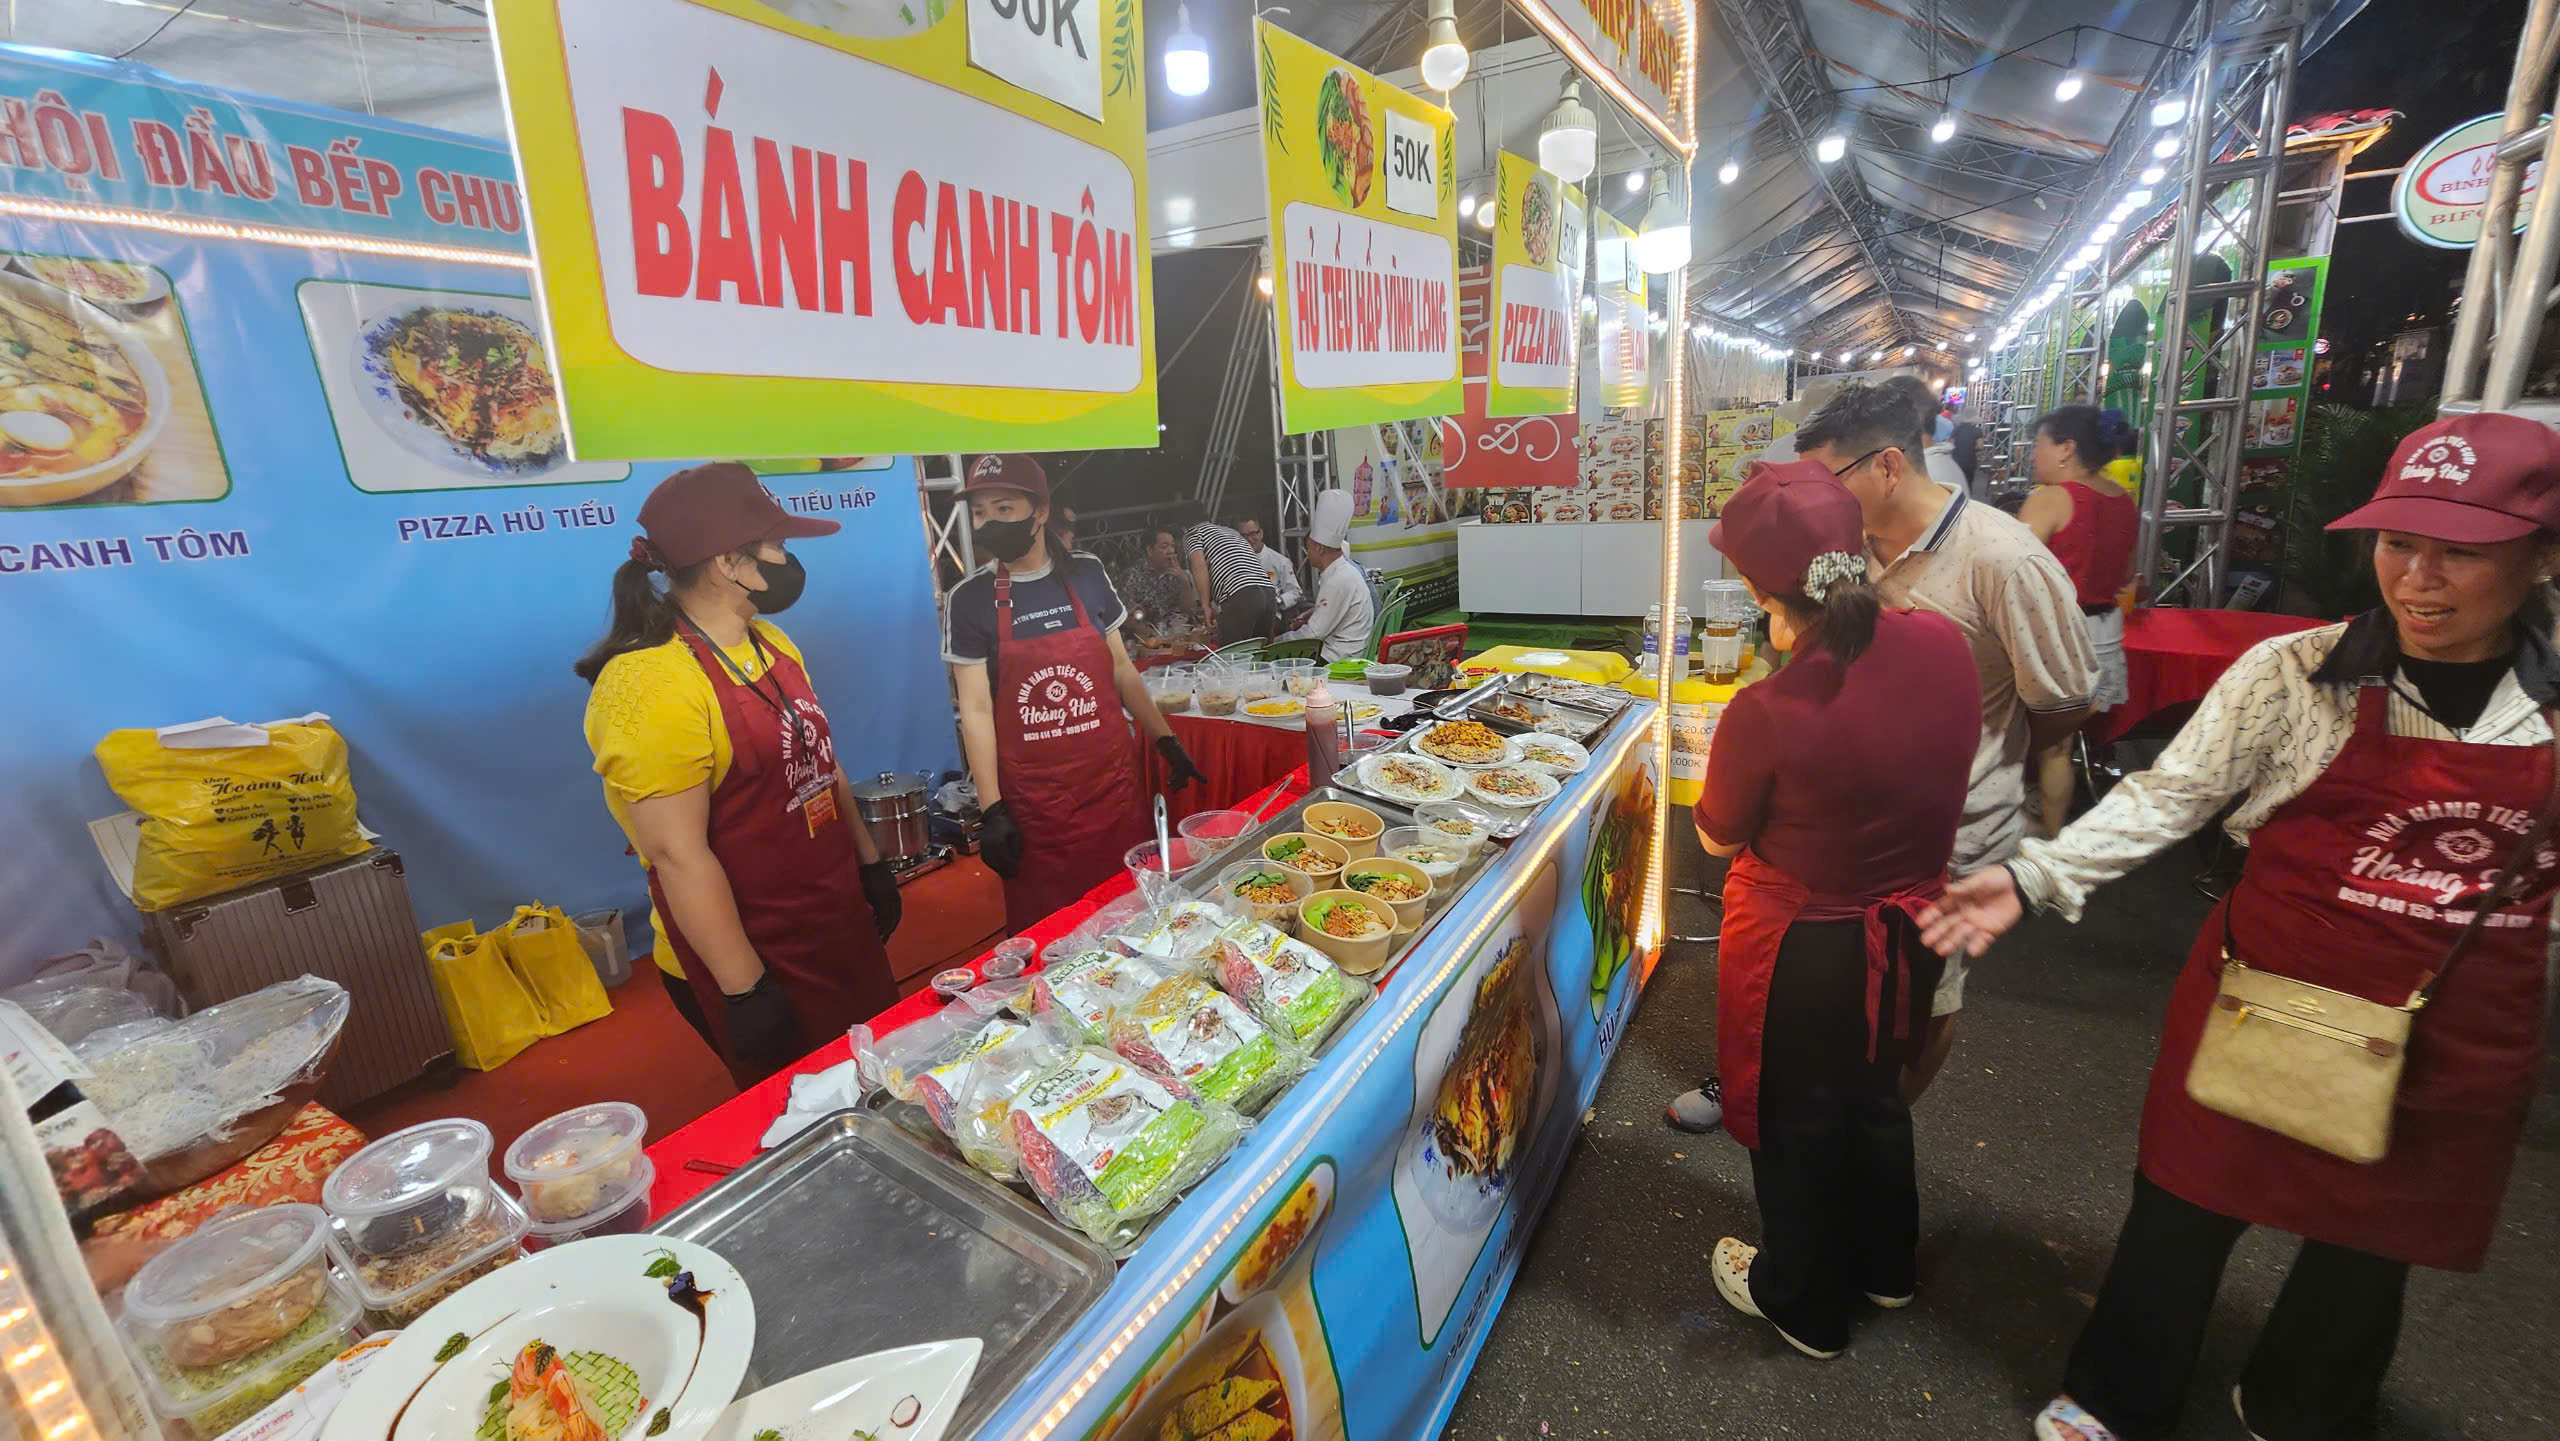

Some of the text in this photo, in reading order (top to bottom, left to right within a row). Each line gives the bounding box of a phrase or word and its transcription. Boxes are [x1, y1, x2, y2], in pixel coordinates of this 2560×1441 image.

[0, 91, 523, 233] HỘI ĐẦU BẾP CHU
[1394, 134, 1432, 184] 50K
[623, 66, 1134, 346] BÁNH CANH TÔM
[1563, 222, 1579, 257] 50K
[1296, 226, 1320, 353] HỦ
[1322, 221, 1353, 353] TIẾU
[1355, 226, 1382, 353] HẤP
[1416, 278, 1447, 353] LONG
[1502, 302, 1544, 365] PIZZA
[788, 486, 876, 512] TIẾU HẤP
[398, 500, 616, 541] PIZZA HỦ TIẾU
[0, 528, 249, 572] CANH TÔM
[1029, 611, 1049, 621] WORD
[1059, 605, 1073, 613] THE
[1028, 666, 1054, 685] HÀNG
[1056, 664, 1077, 679] TIỆC
[1020, 696, 1097, 726] Hoàng Huệ
[1684, 725, 1714, 735] 20.00
[2366, 800, 2537, 842] NHÀ HÀNG TIỆC
[2351, 846, 2468, 905] Hoàng
